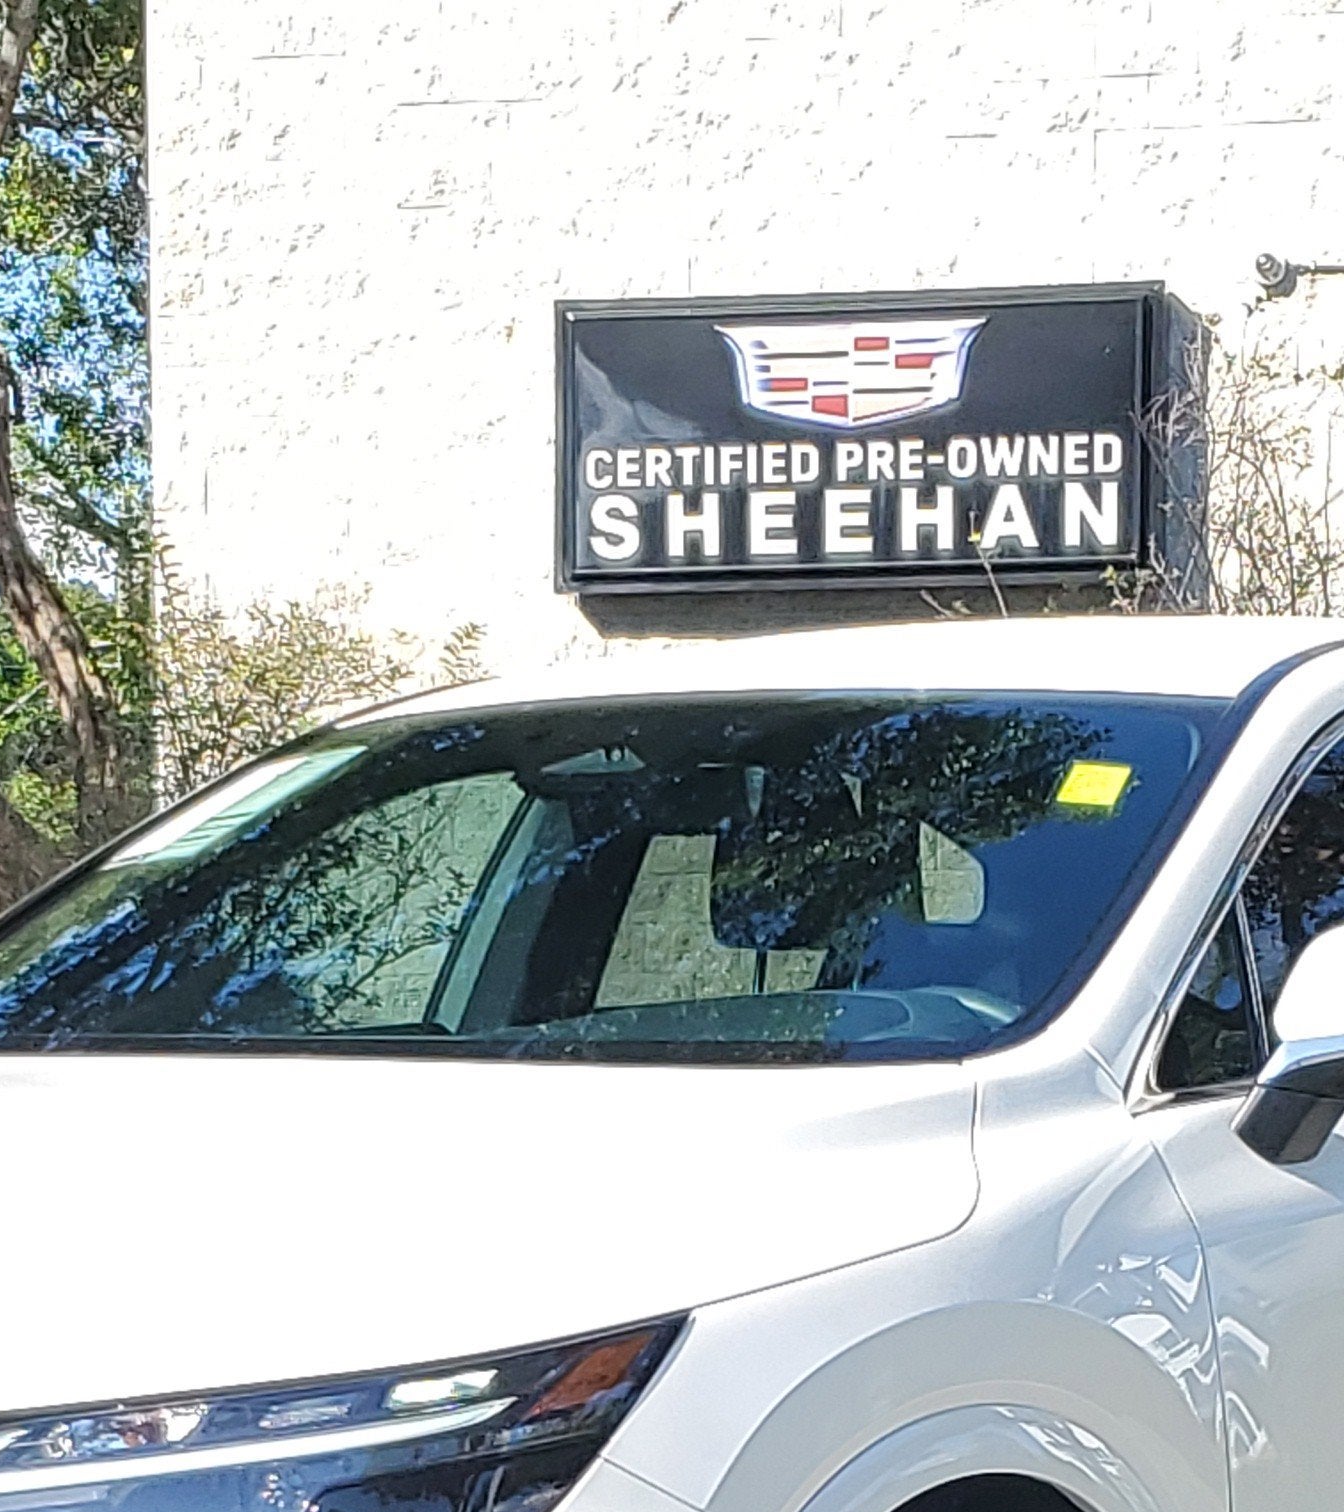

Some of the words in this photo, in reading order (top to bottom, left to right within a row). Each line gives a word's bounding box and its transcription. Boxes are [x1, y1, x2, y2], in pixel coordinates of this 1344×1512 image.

[585, 442, 820, 490] CERTIFIED
[836, 433, 1123, 482] PRE-OWNED
[589, 481, 1119, 561] SHEEHAN
